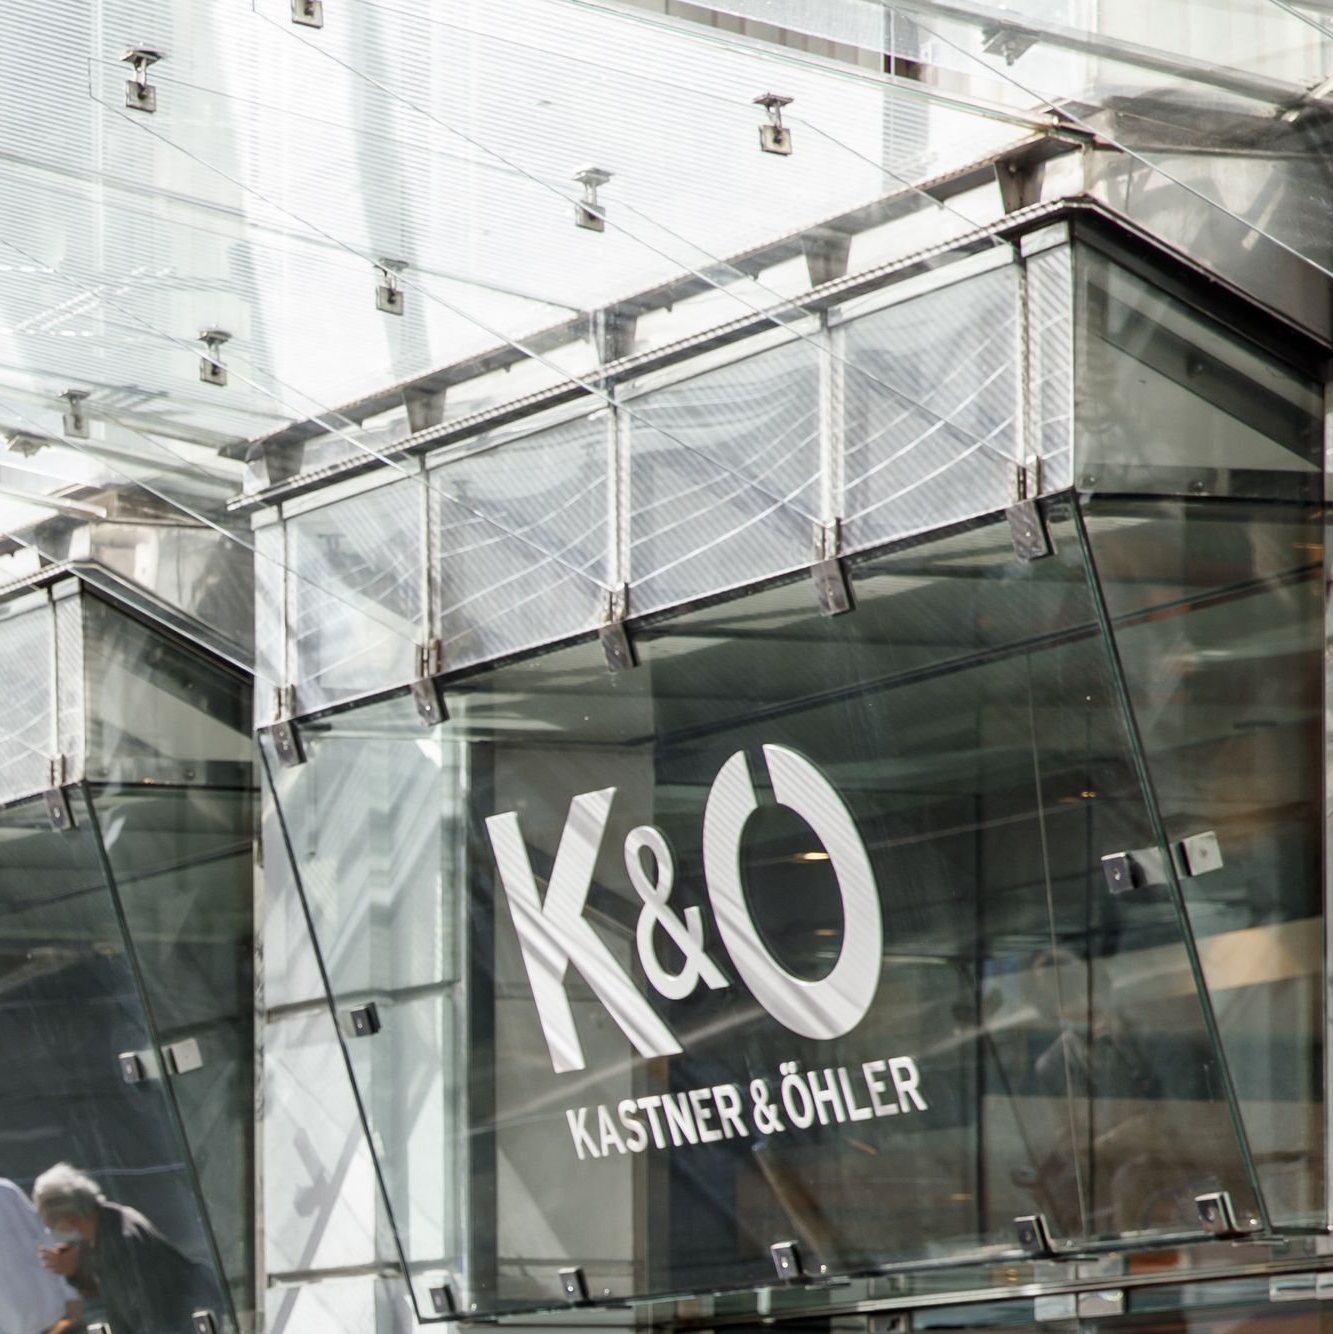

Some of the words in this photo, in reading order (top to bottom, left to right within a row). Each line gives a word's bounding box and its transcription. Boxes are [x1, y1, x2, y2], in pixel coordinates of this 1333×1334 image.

[484, 743, 884, 1074] K&O
[566, 1083, 749, 1161] KASTNER
[779, 1056, 928, 1129] ÖHLER
